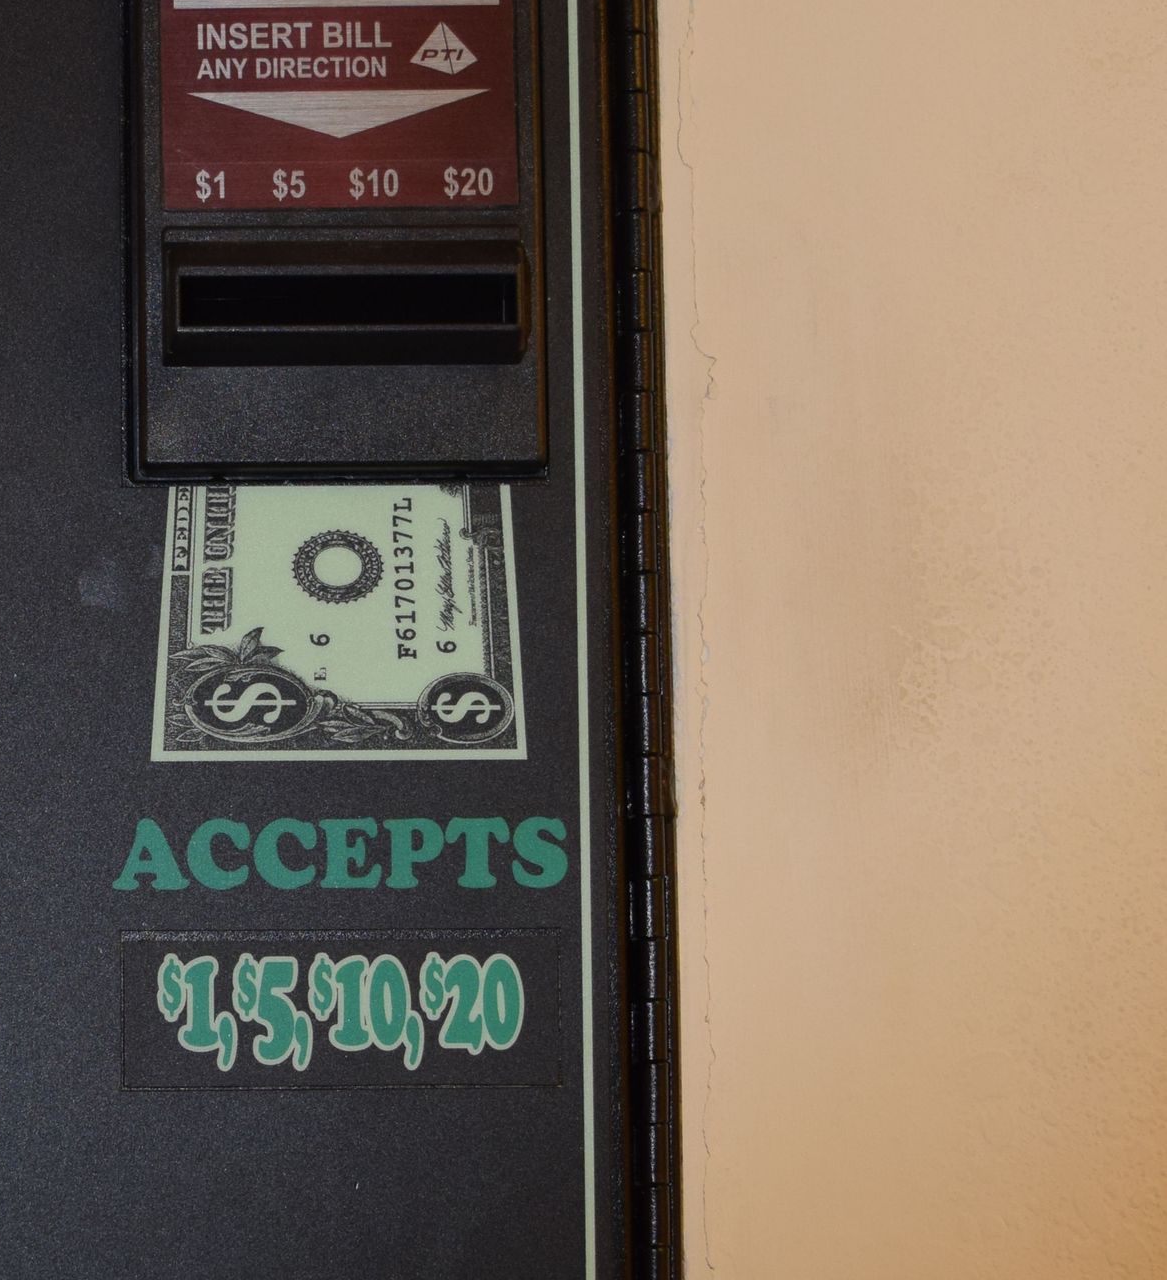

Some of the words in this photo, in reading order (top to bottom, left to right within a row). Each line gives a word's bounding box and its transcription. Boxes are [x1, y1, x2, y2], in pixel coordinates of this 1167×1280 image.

[196, 22, 313, 50] INSERT
[322, 21, 393, 49] BILL
[196, 58, 249, 79] ANY
[255, 56, 387, 79] DIRECTION
[419, 48, 465, 62] PTI
[195, 169, 226, 203] $1
[272, 168, 307, 201] $5
[349, 167, 400, 200] $10
[443, 166, 494, 199] $20
[392, 497, 417, 659] F61701377L
[309, 633, 330, 646] 6
[435, 640, 457, 654] 6
[112, 817, 568, 890] ACCEPTS
